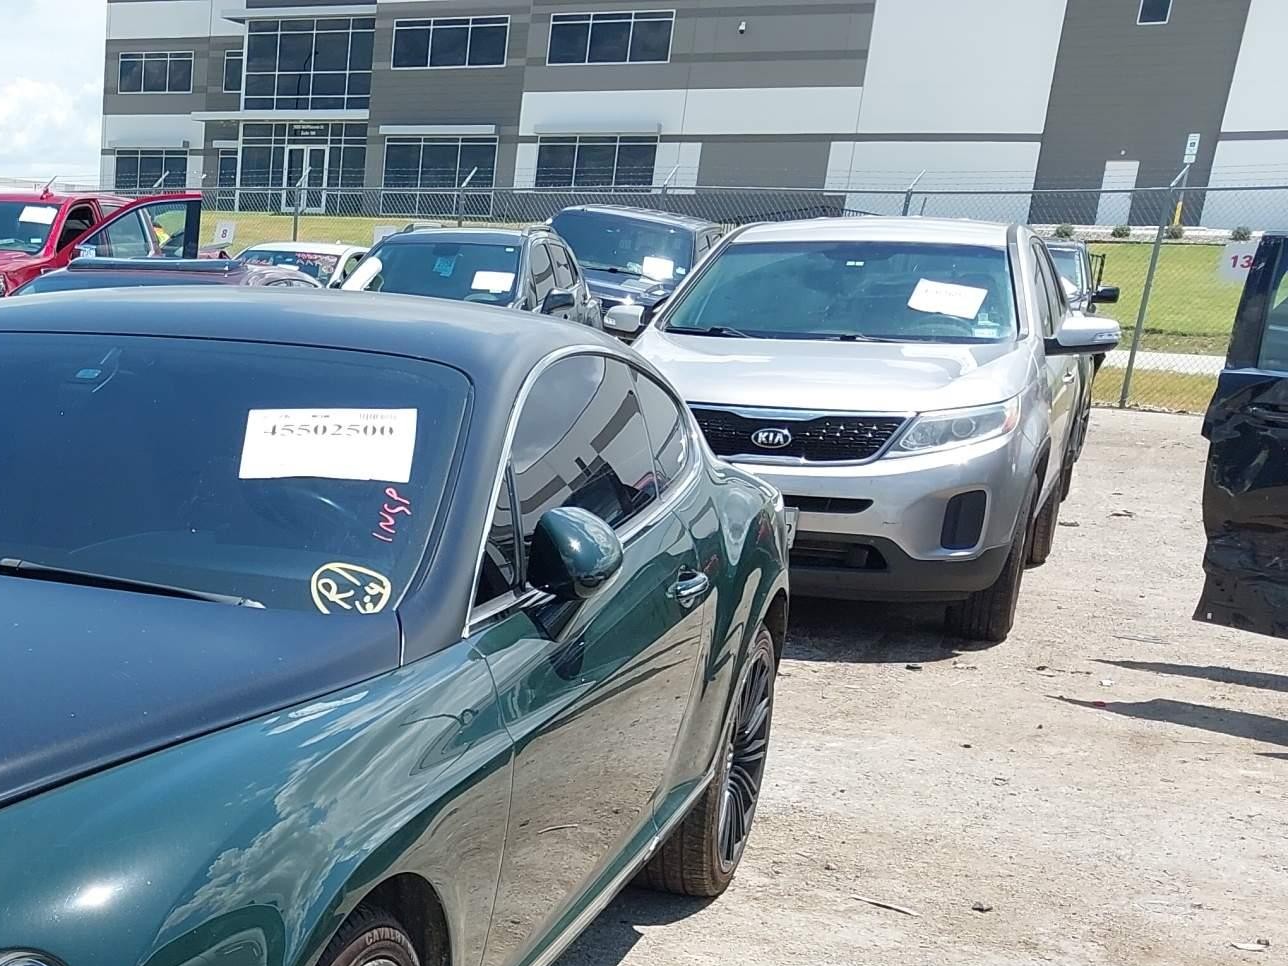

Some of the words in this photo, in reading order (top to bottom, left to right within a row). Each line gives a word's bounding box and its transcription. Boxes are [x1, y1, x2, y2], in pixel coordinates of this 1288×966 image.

[221, 229, 228, 239] 8
[263, 423, 395, 437] 45502500
[757, 431, 785, 445] KIA
[372, 487, 412, 542] INSP
